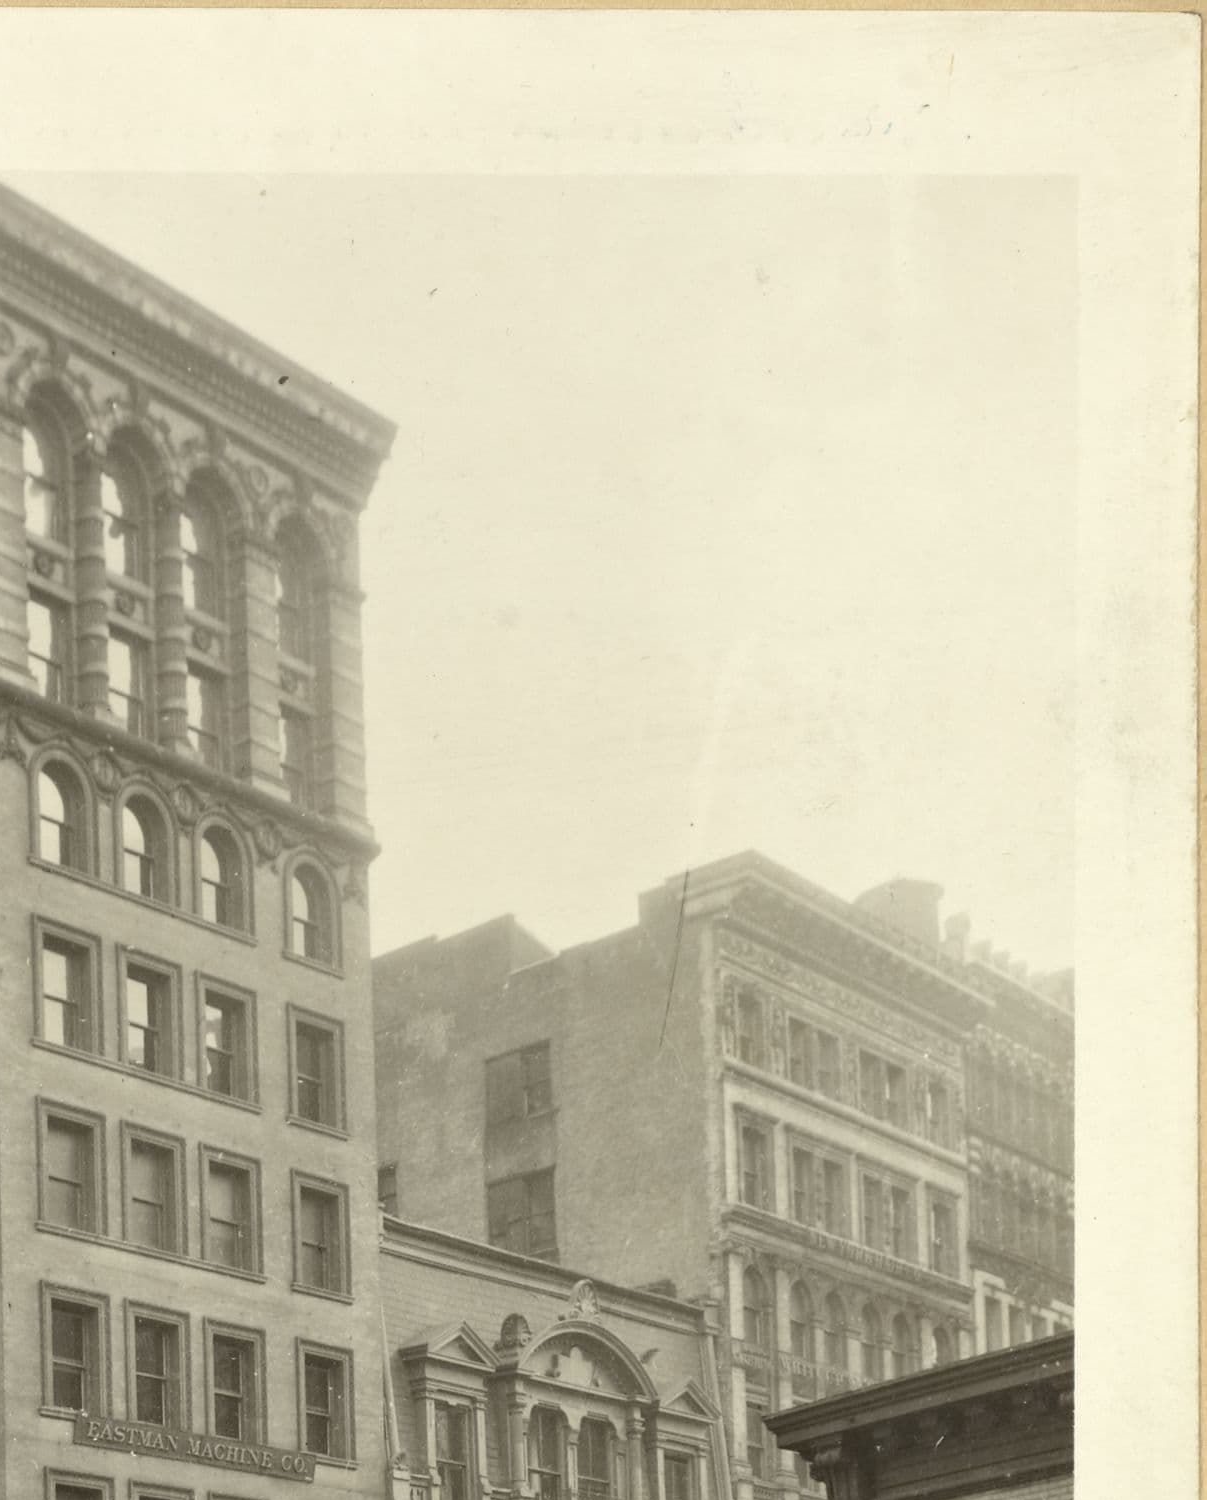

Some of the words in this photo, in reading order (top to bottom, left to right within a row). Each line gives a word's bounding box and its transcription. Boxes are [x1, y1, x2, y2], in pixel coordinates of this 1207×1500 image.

[87, 1420, 180, 1452] EASTMAN
[186, 1439, 274, 1470] MACHINE
[281, 1454, 309, 1474] CO.
